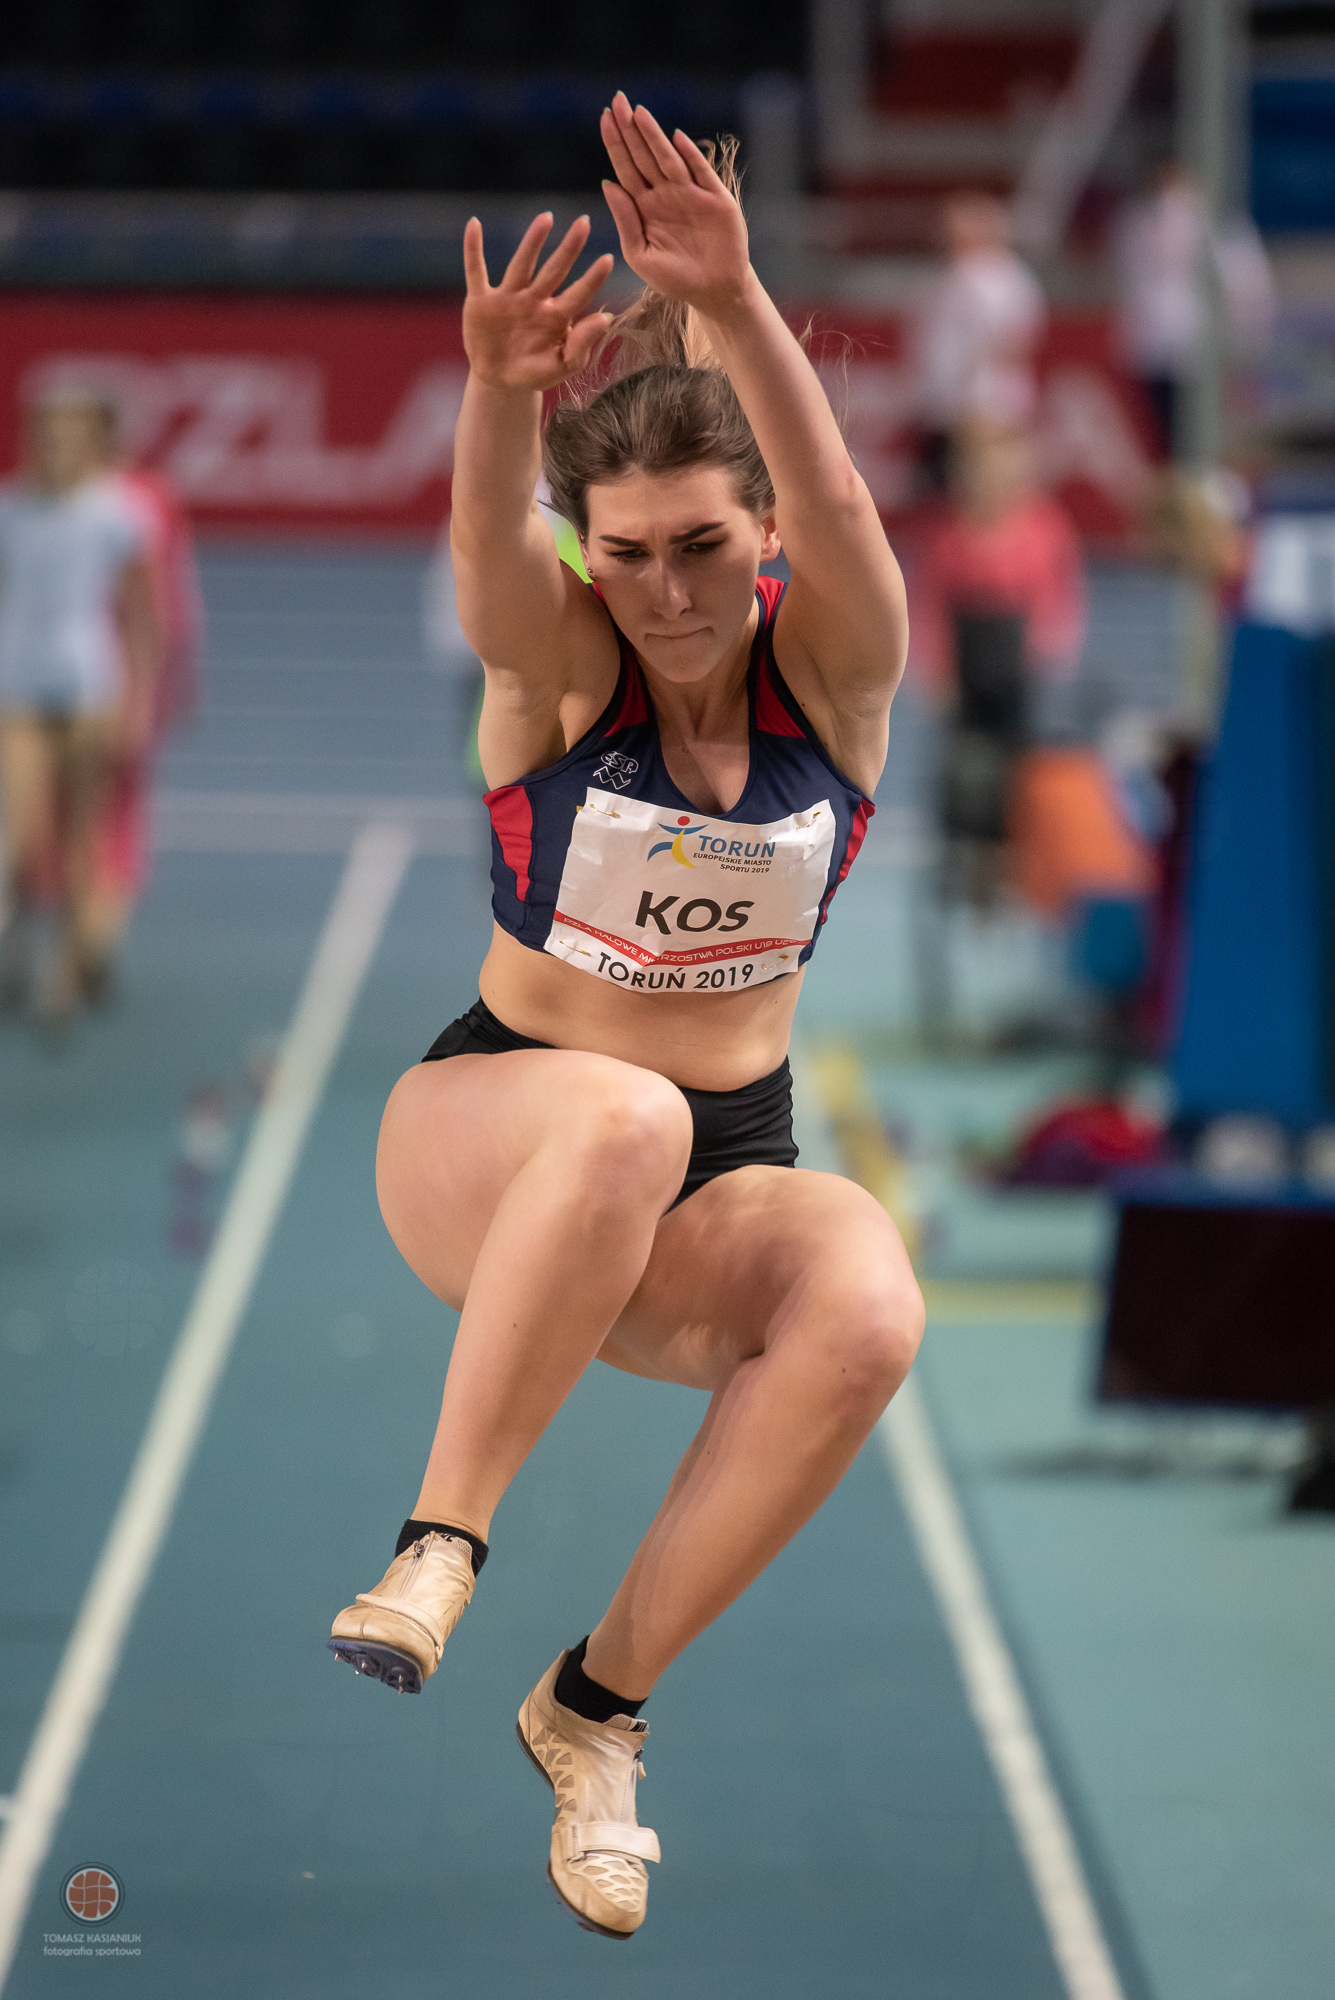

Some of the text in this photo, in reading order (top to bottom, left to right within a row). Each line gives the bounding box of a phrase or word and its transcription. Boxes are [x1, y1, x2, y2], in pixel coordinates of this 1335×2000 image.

[693, 852, 742, 865] EUROPEJSKIE
[719, 864, 750, 873] SPORTU
[634, 890, 755, 935] KOS
[594, 930, 638, 955] HALOWE
[638, 949, 714, 964] MIRZOSTWA
[715, 944, 752, 957] POLSKI
[597, 951, 754, 989] TORUŃ 2019
